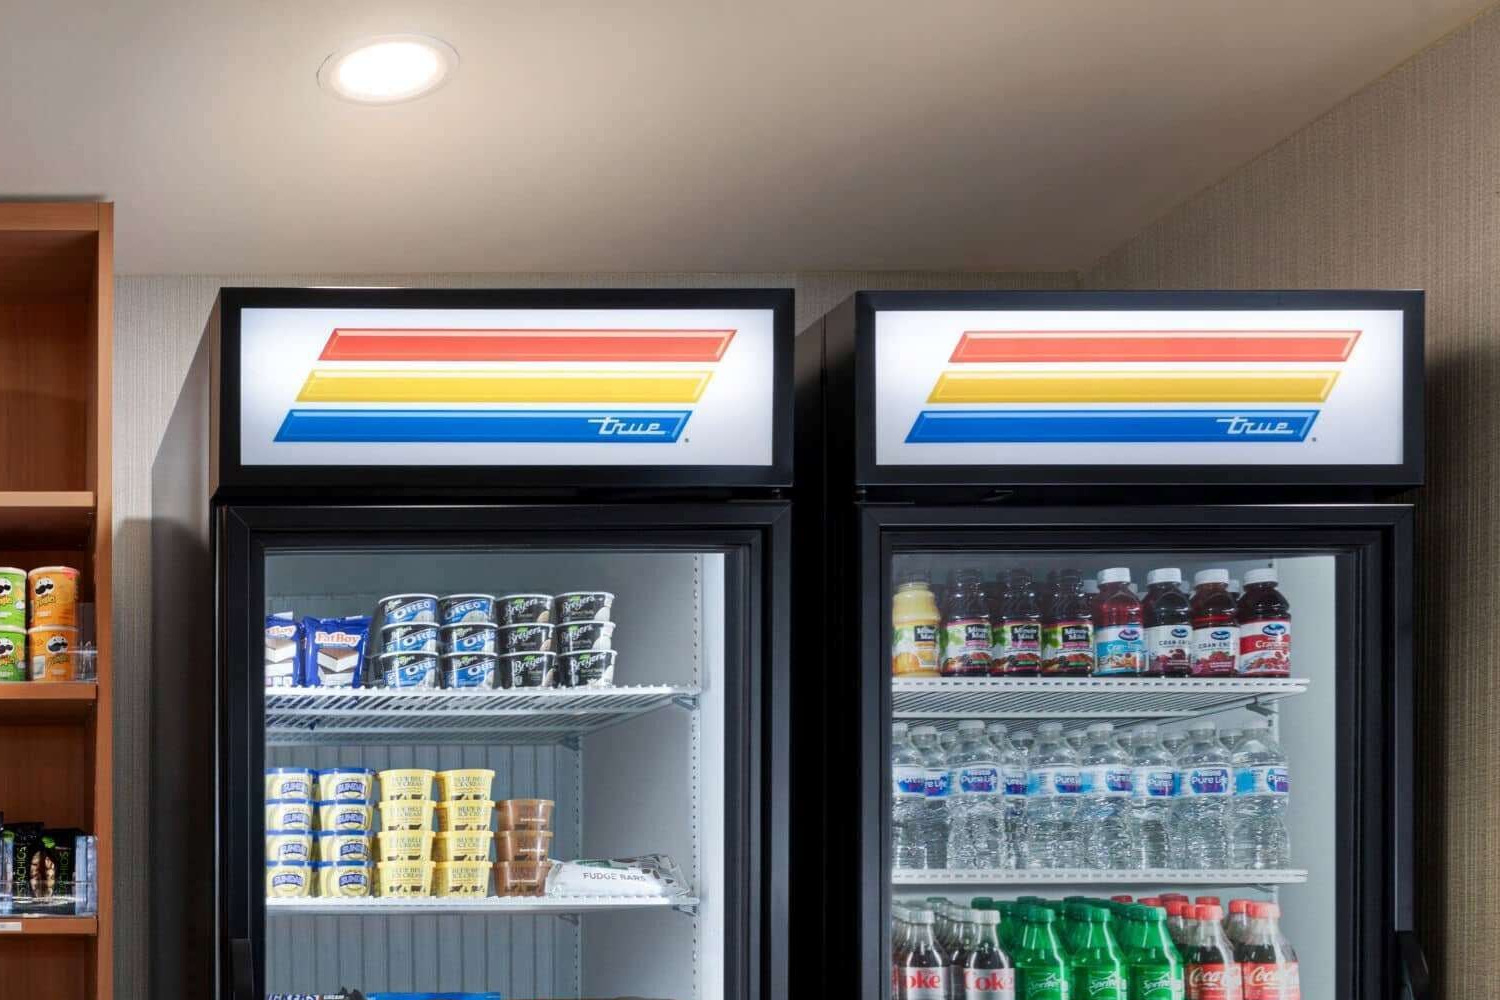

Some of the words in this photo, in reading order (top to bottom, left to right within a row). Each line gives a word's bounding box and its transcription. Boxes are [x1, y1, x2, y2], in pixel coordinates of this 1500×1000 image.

[588, 416, 667, 434] true
[1216, 416, 1294, 434] true
[583, 872, 617, 880] FUDGE
